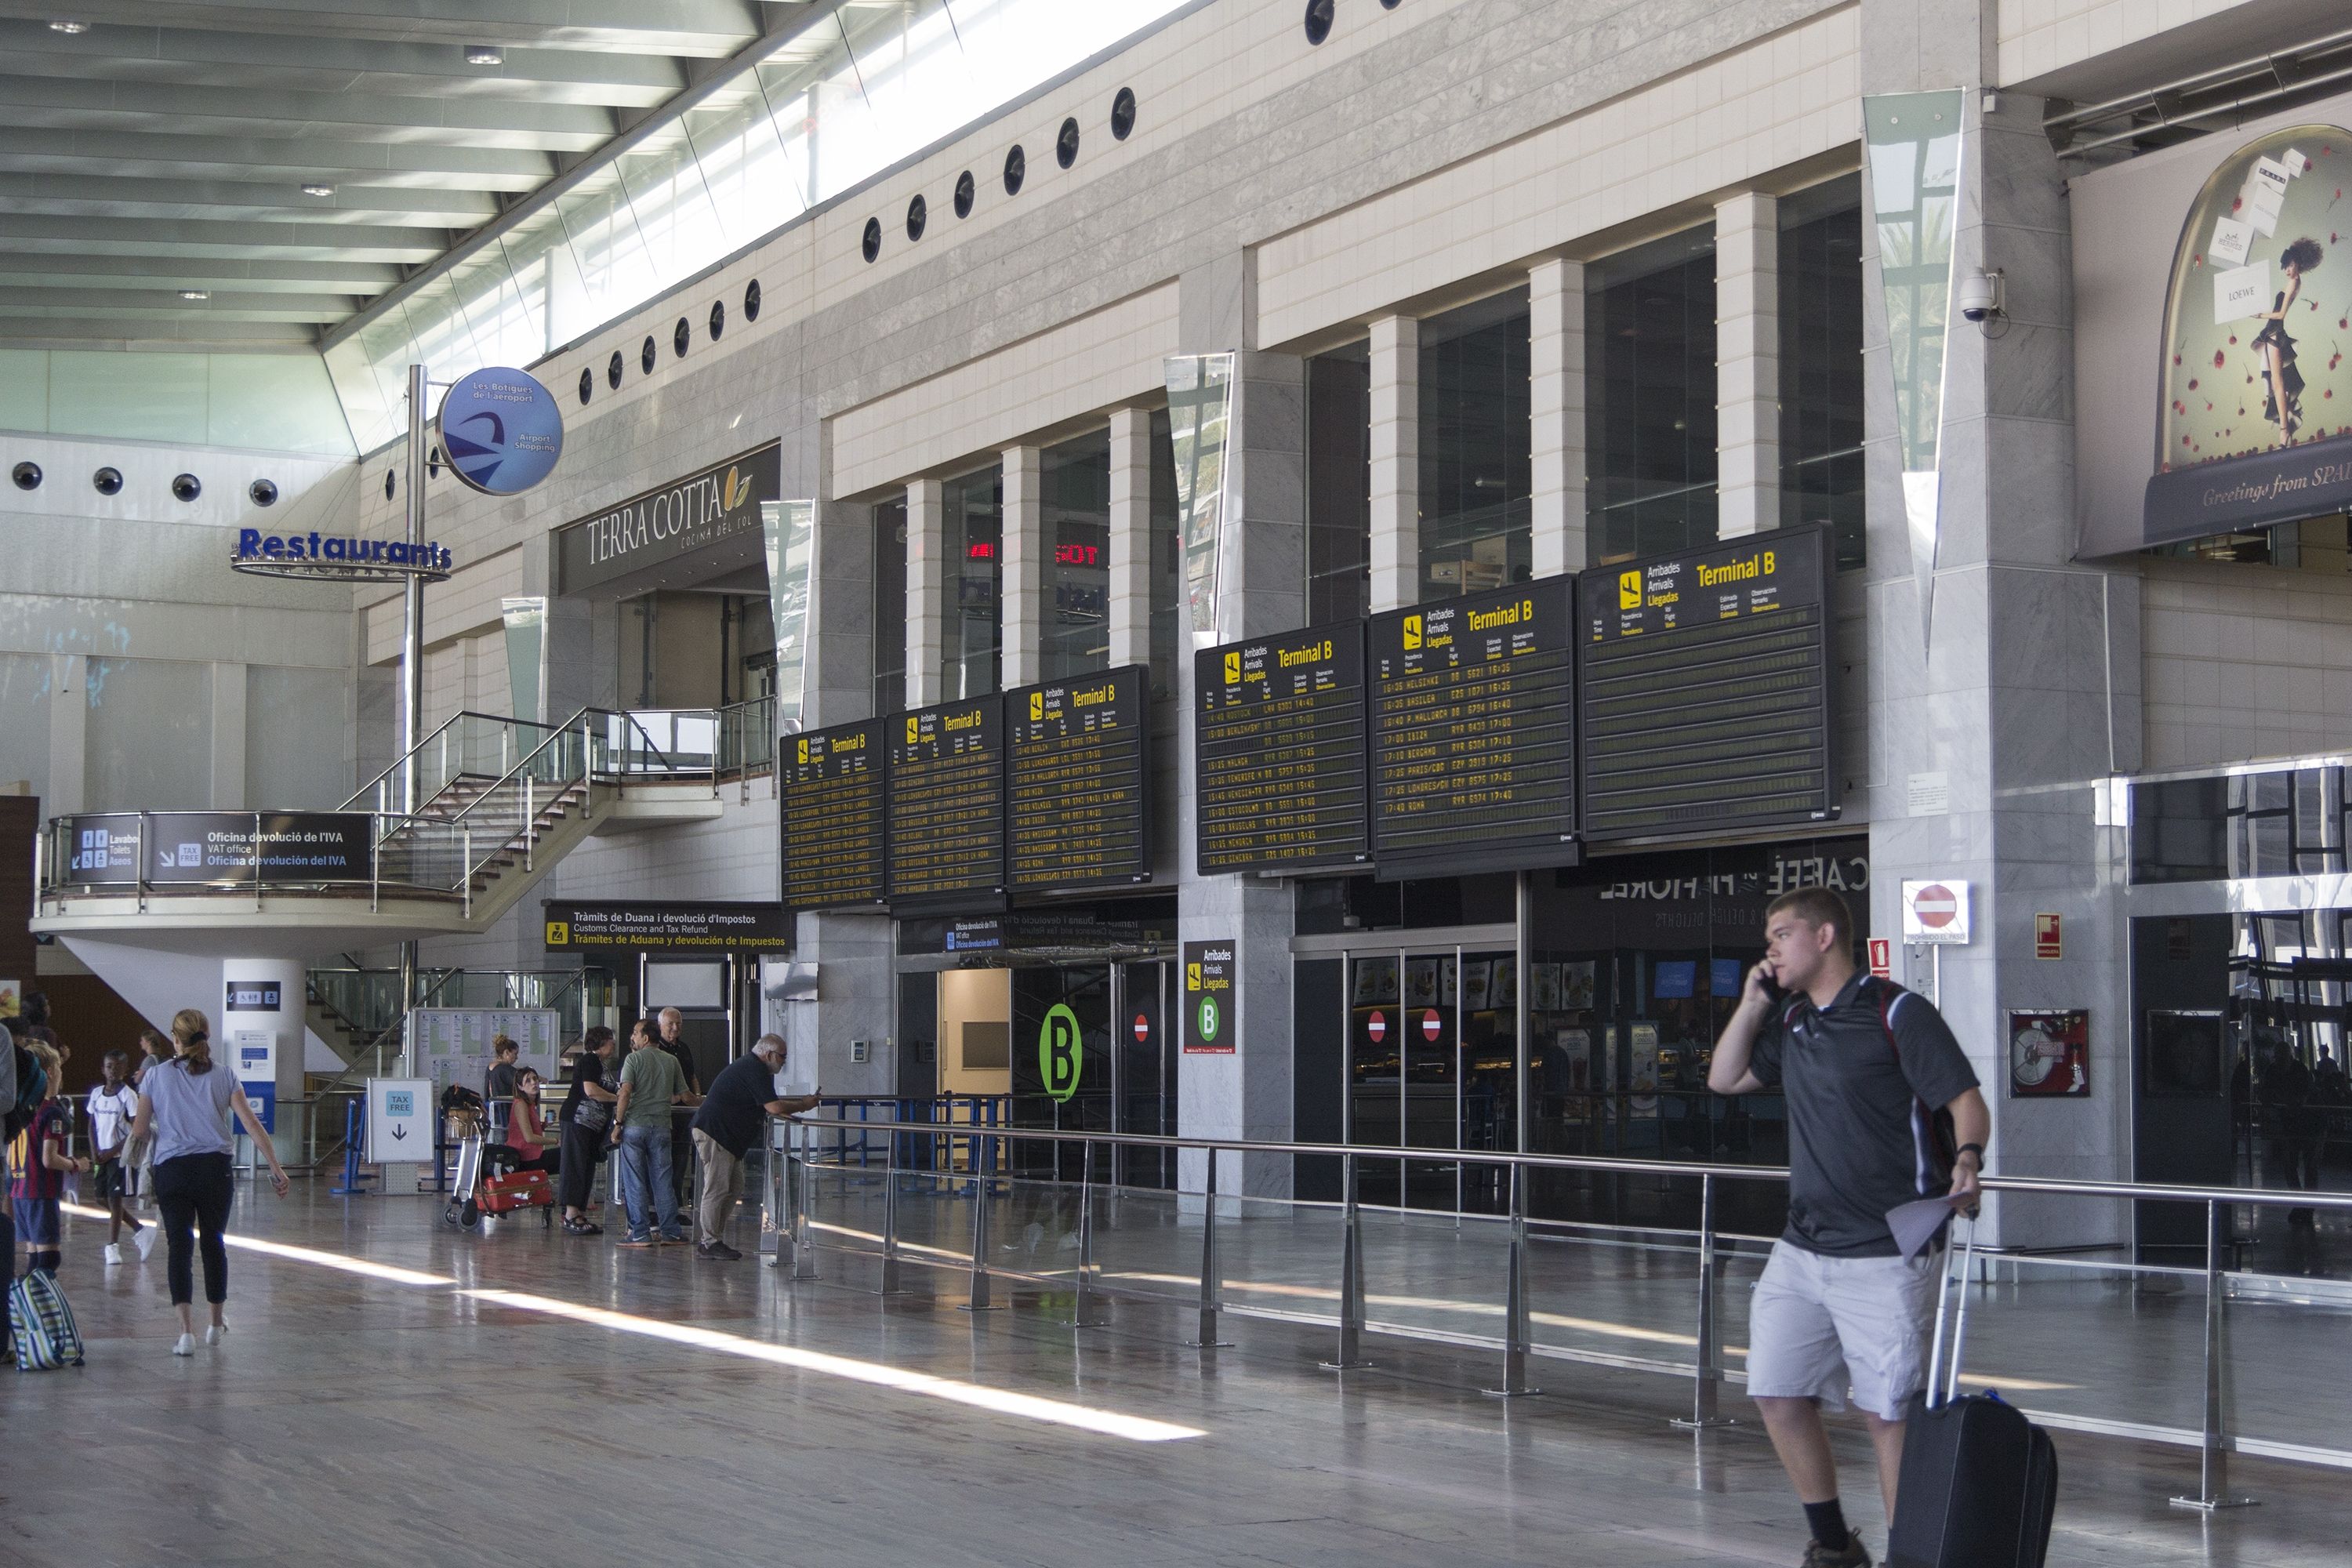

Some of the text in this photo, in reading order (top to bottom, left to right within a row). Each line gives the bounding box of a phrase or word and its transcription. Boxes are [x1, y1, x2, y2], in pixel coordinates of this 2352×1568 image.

[2229, 286, 2255, 301] LOEWE
[492, 383, 533, 394] Botigues
[520, 434, 550, 443] Airport
[515, 442, 555, 452] Shopping
[2204, 482, 2269, 506] Greetings
[2270, 474, 2307, 499] from
[588, 474, 723, 564] TERRA COTTA
[239, 528, 452, 569] Restaurants
[1647, 561, 1680, 579] Arribades
[1697, 552, 1775, 586] Terminal B
[1648, 576, 1673, 593] Arrivals
[1648, 590, 1679, 608] Llegadas
[1427, 606, 1454, 622] Arribades
[1468, 601, 1532, 630] Terminal B
[1427, 621, 1449, 635] Arrivals
[1427, 633, 1452, 649] Llegadas
[1244, 645, 1267, 659] Arribades
[1278, 641, 1332, 667] Terminal B
[1244, 658, 1262, 670] Arrivals
[1244, 669, 1265, 684] Llegadas
[1383, 681, 1403, 693] 16:35
[1488, 662, 1509, 675] 16:35
[1045, 687, 1064, 699] Arribades
[1073, 685, 1114, 707] Terminal B
[1384, 681, 1510, 710] 16:35 16:35
[1046, 698, 1060, 709] Arrivals
[1296, 698, 1313, 709] 14:40
[1489, 699, 1510, 711] 16:40
[943, 711, 981, 731] Terminal B
[1046, 708, 1062, 720] Llegadas
[1384, 733, 1403, 744] 17:00
[1489, 717, 1510, 729] 17:00
[831, 734, 865, 753] Terminal B
[1385, 750, 1403, 761] 17:10
[1490, 735, 1511, 747] 17:10
[1297, 763, 1314, 774] 15:35
[1385, 753, 1511, 779] 17:25 17:25
[1297, 780, 1314, 790] 15:45
[1385, 771, 1512, 796] 17:25 17:25
[1385, 789, 1512, 813] 17:40 ROMA 17:40
[208, 832, 343, 842] Oficina devolució de l'IVA
[110, 846, 131, 855] Toilets
[227, 844, 251, 853] office
[109, 857, 132, 866] Aseos
[208, 855, 347, 866] Oficina devolución del IVA
[574, 913, 608, 922] Tràmits
[611, 913, 622, 922] de
[626, 913, 655, 922] Duana
[663, 913, 705, 923] devolució
[709, 914, 756, 925] d'Impostos
[610, 924, 647, 933] Clearance
[681, 925, 708, 934] Refund
[574, 934, 785, 947] Trámites de Aduana y devolución de Impuestos
[1204, 949, 1231, 960] Arribades
[1204, 964, 1222, 974] Arrivals
[1204, 978, 1229, 991] Llegadas
[1204, 1005, 1214, 1033] B
[1051, 1016, 1074, 1091] B
